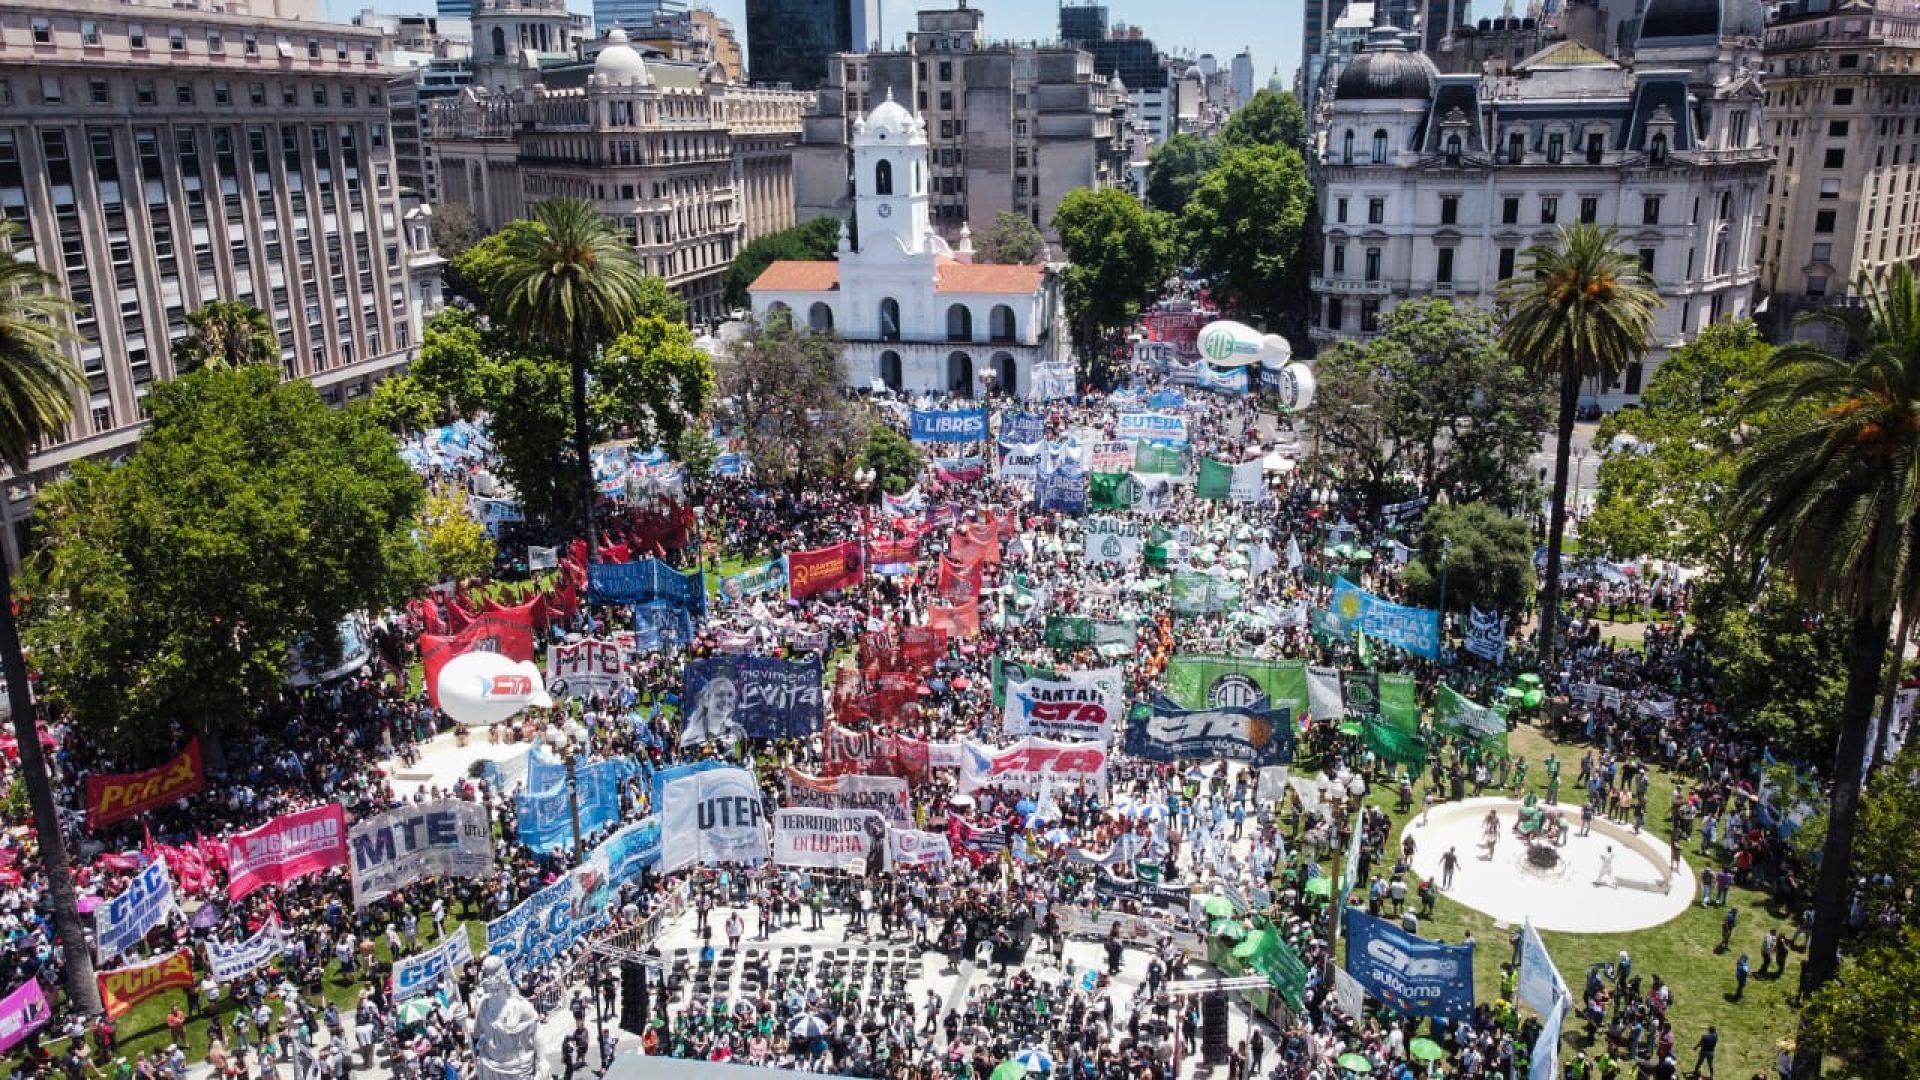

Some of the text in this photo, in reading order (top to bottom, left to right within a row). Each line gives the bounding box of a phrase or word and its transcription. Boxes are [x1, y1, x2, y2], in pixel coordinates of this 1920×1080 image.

[925, 417, 982, 435] LIBRES
[1088, 518, 1136, 537] SALUD
[1031, 686, 1088, 701] SANTA
[1031, 702, 1107, 724] CTA
[989, 747, 1105, 776] CTA
[698, 796, 762, 830] UTEP
[782, 815, 862, 832] TERRITORIOS
[353, 811, 459, 872] MTE
[812, 834, 864, 853] LUCHA
